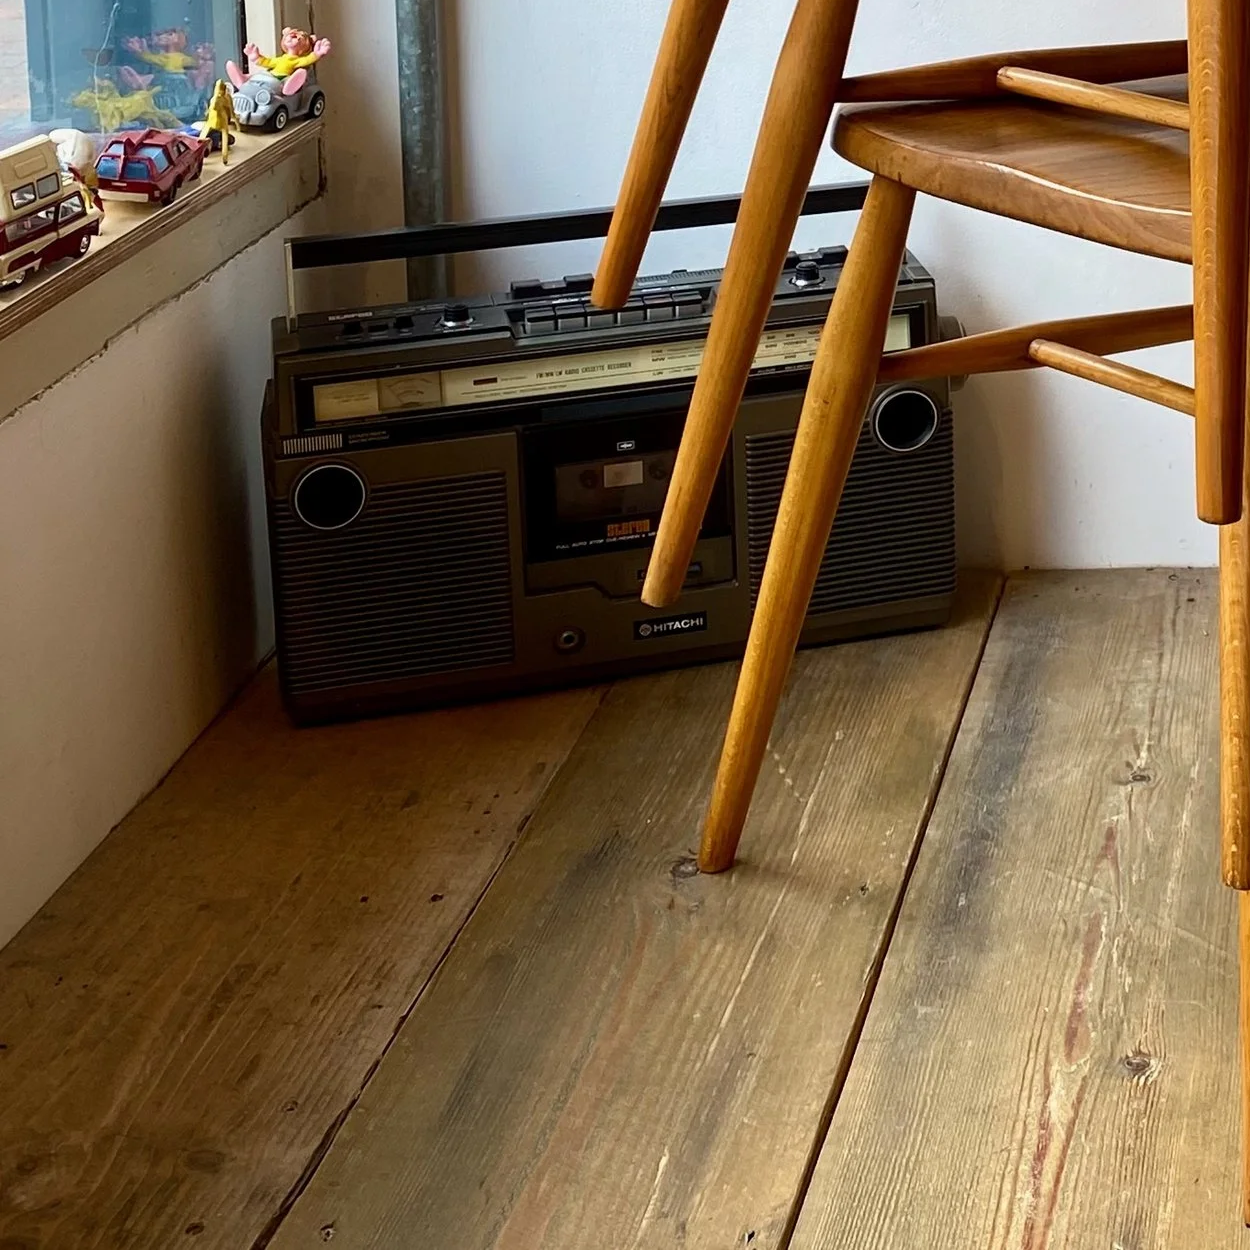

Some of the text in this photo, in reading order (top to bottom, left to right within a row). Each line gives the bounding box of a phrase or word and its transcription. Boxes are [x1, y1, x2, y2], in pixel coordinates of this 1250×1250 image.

[581, 364, 605, 374] CASSETTE
[607, 361, 632, 371] RECORDER
[653, 617, 704, 633] HITACHI
